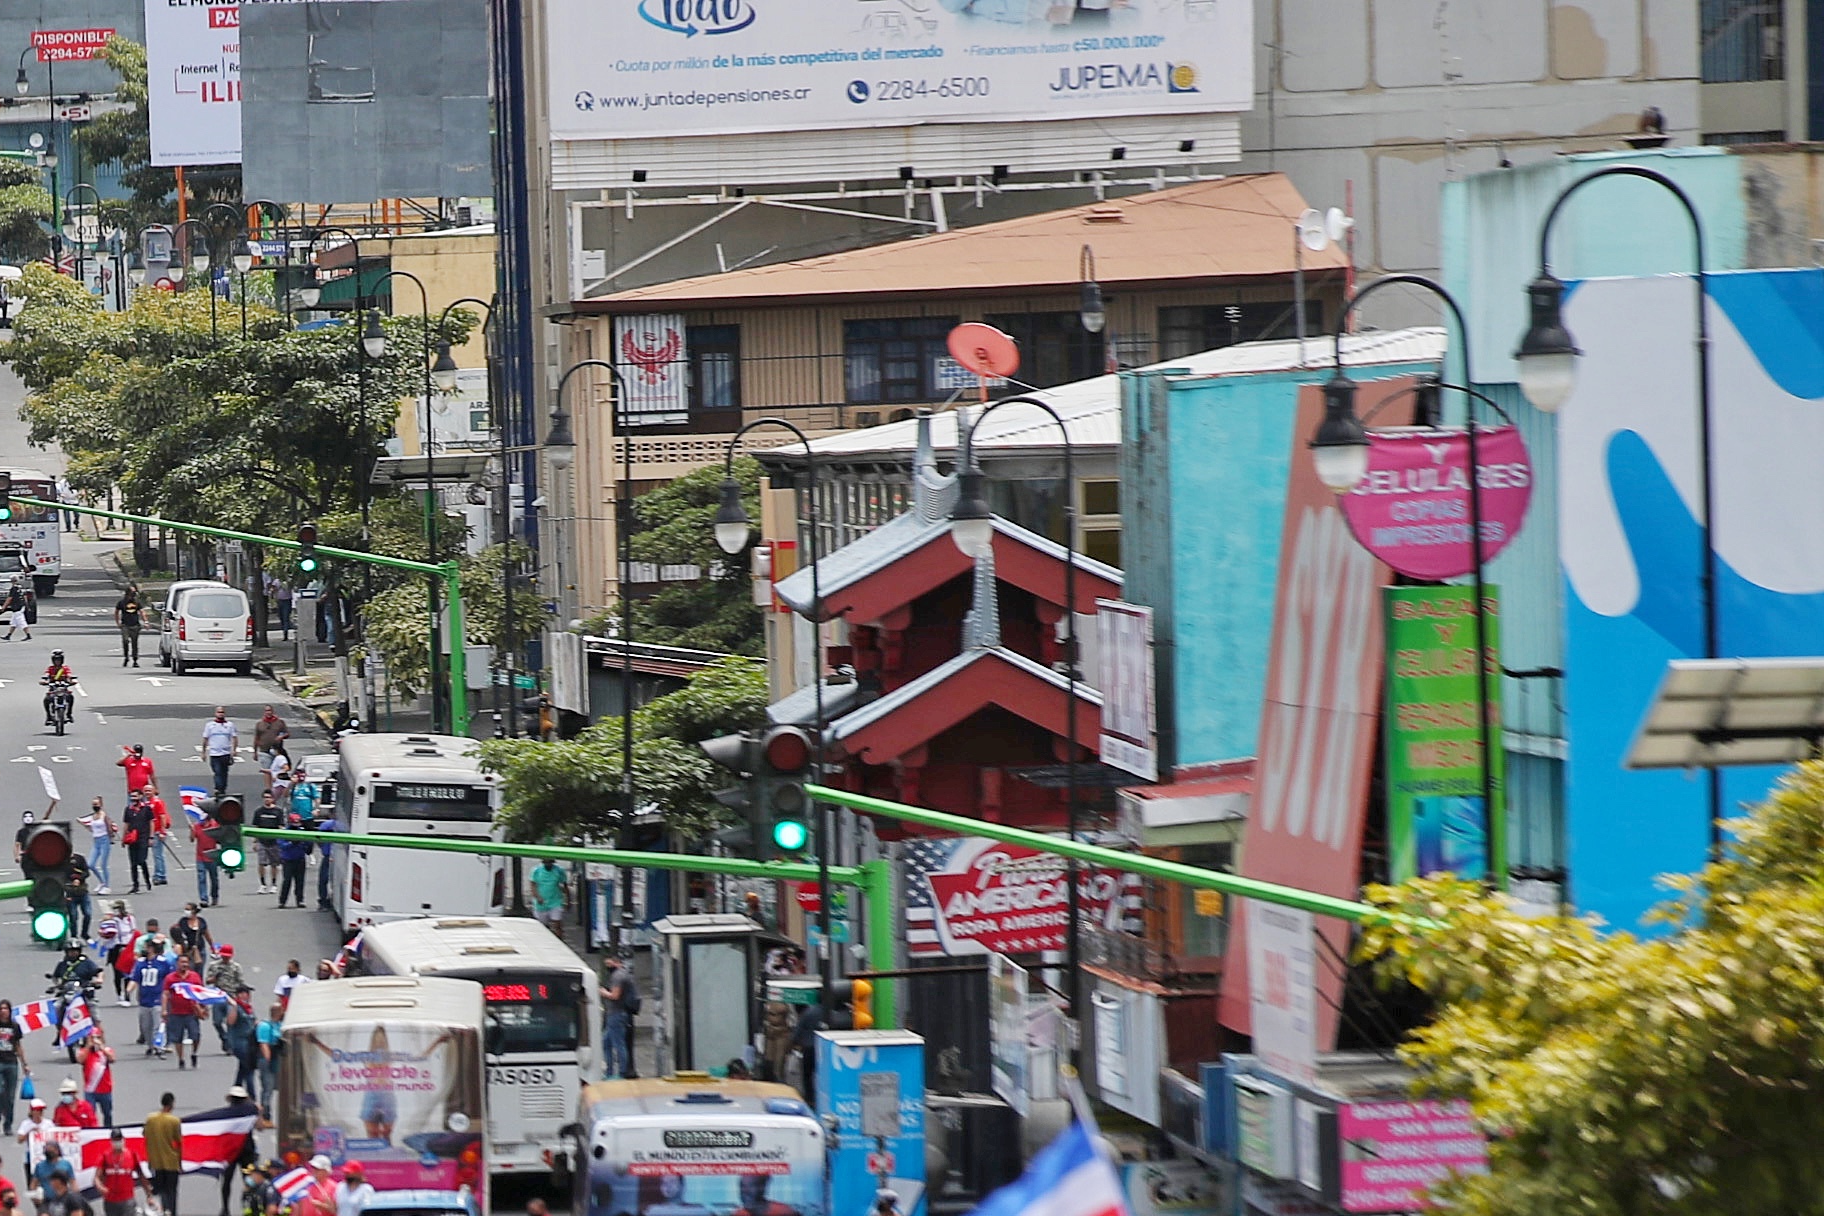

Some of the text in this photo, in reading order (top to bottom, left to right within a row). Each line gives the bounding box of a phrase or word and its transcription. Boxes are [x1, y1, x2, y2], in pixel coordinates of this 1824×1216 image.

[33, 31, 112, 46] DISPONIBLE
[181, 63, 218, 74] Internet
[616, 45, 943, 73] Cuota por millón de la más competitiva del mercado
[1049, 63, 1162, 91] JUPEMA
[599, 87, 812, 110] www.juntadepensiones.cr
[875, 77, 990, 101] 2284-6500
[1425, 443, 1451, 465] Y
[949, 918, 1000, 938] ROPA
